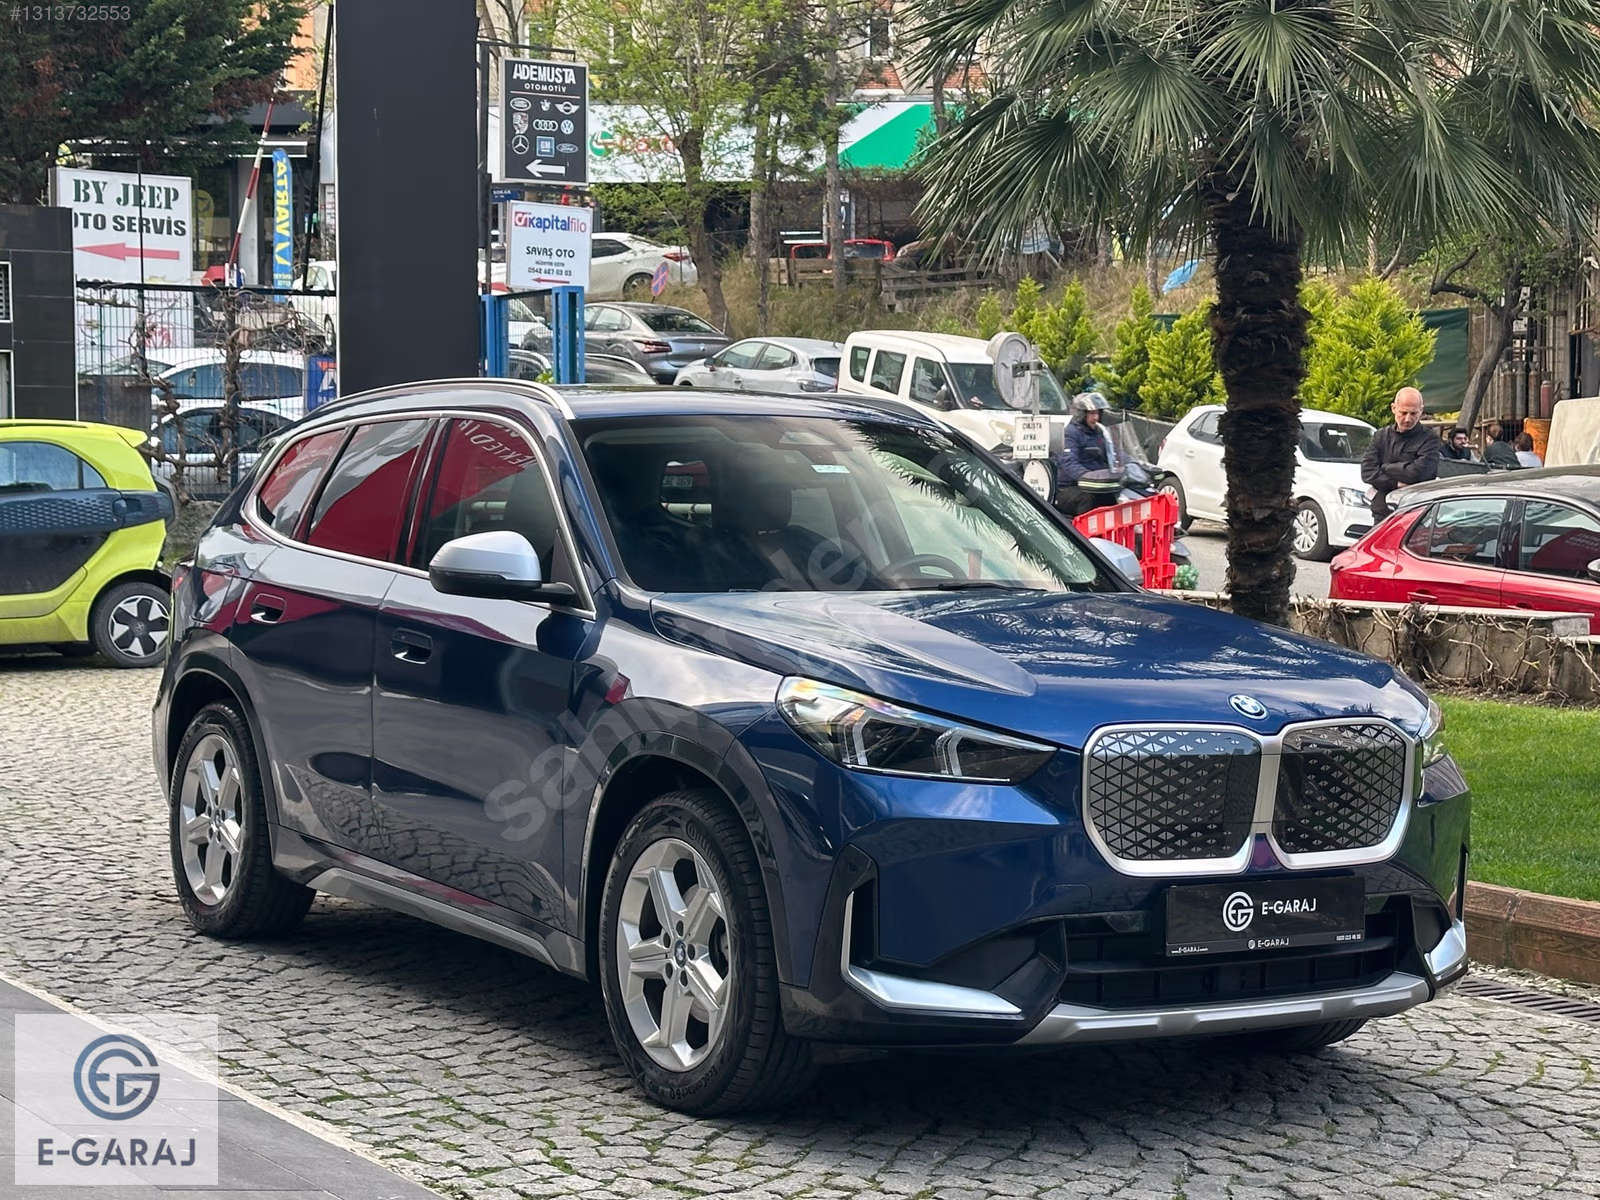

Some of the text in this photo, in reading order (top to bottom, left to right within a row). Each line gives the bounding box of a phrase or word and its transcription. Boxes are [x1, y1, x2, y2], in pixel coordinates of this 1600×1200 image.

[512, 63, 576, 84] ADEMUSTA
[524, 83, 567, 92] OTOMOTİV
[73, 178, 179, 210] BY JEEP
[112, 215, 187, 237] SERVİS
[526, 246, 575, 259] SAVAŞ OTO
[1261, 898, 1317, 915] E-GARAJ
[1257, 938, 1290, 948] E-GARAJ
